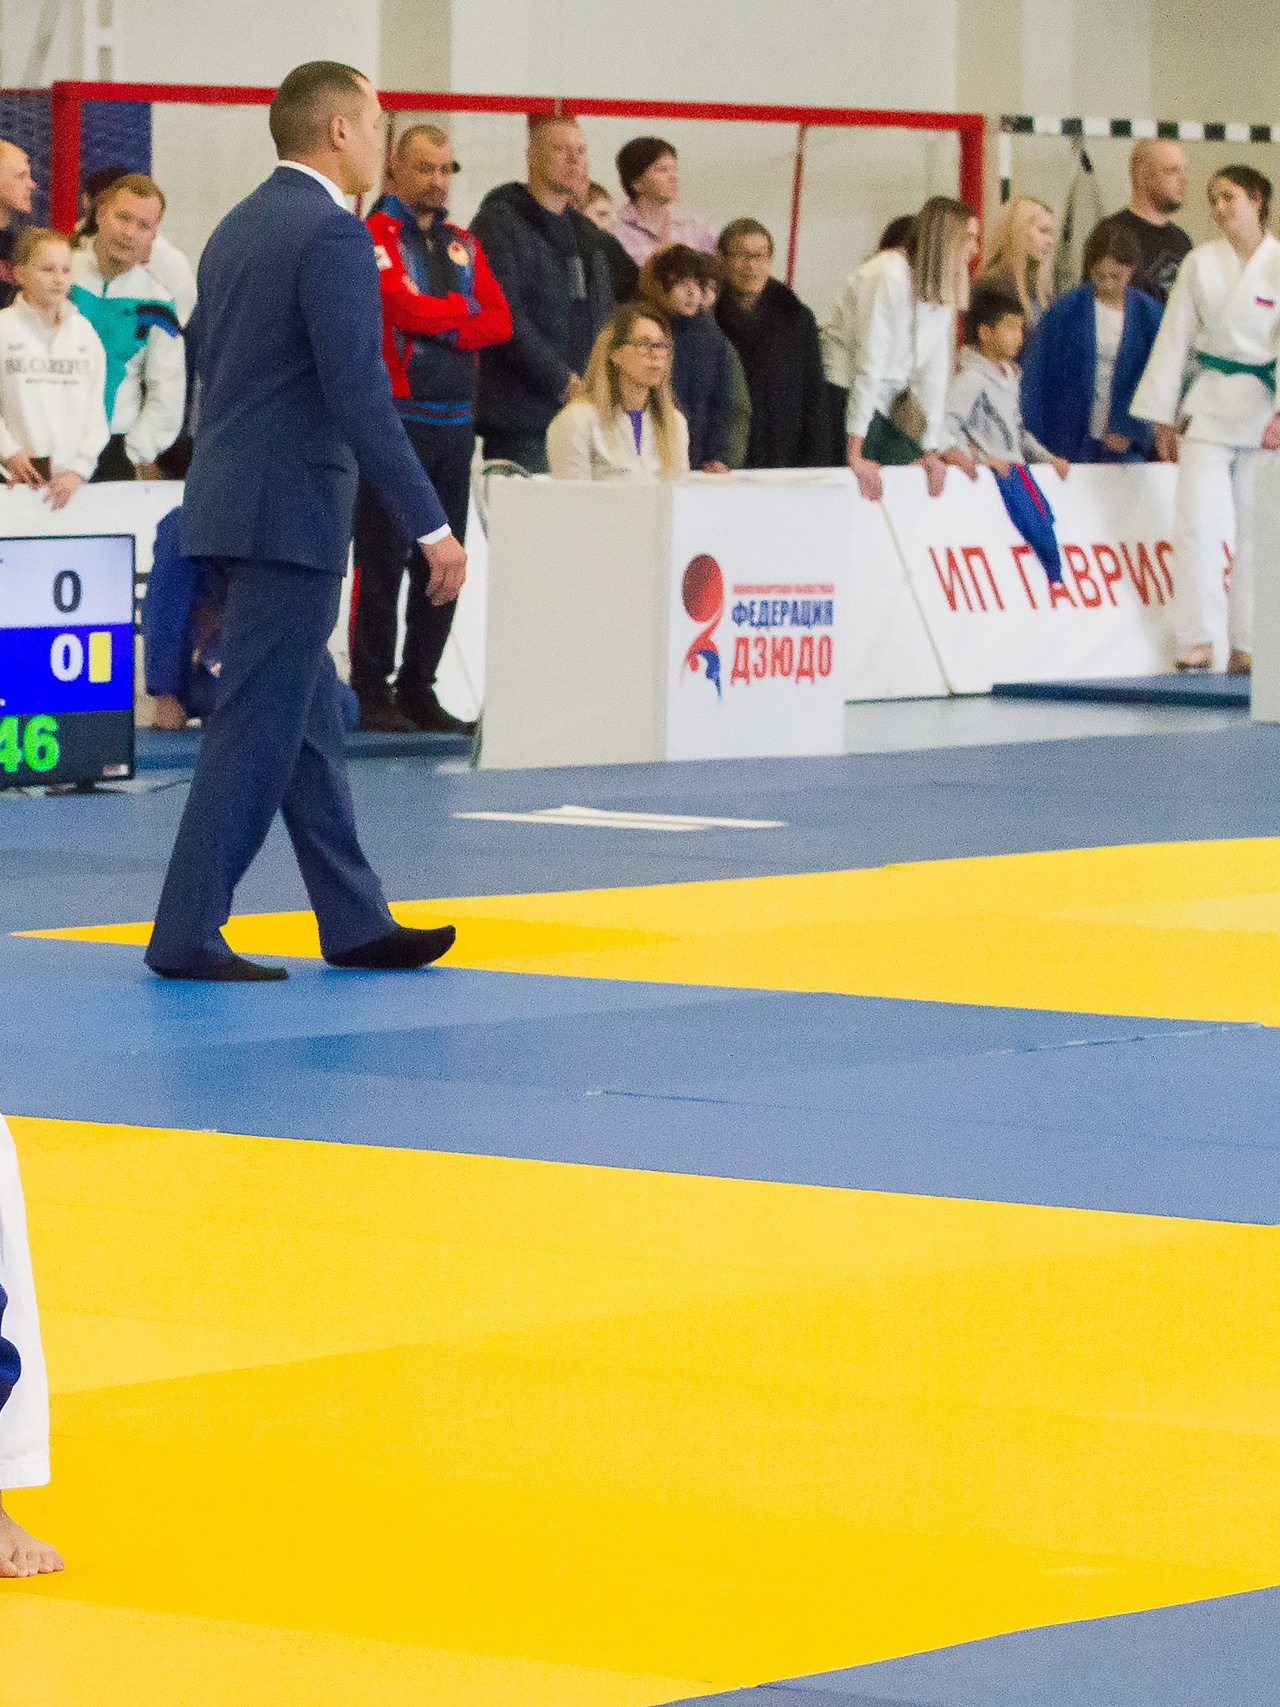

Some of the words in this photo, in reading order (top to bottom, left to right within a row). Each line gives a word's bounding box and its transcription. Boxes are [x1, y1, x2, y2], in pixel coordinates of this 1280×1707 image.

[52, 569, 83, 614] 0
[927, 545, 1005, 612] ИП
[731, 599, 834, 630] ФЕДЕРАЦИЯ
[50, 634, 83, 682] 0
[729, 634, 833, 686] ДЗЮДО
